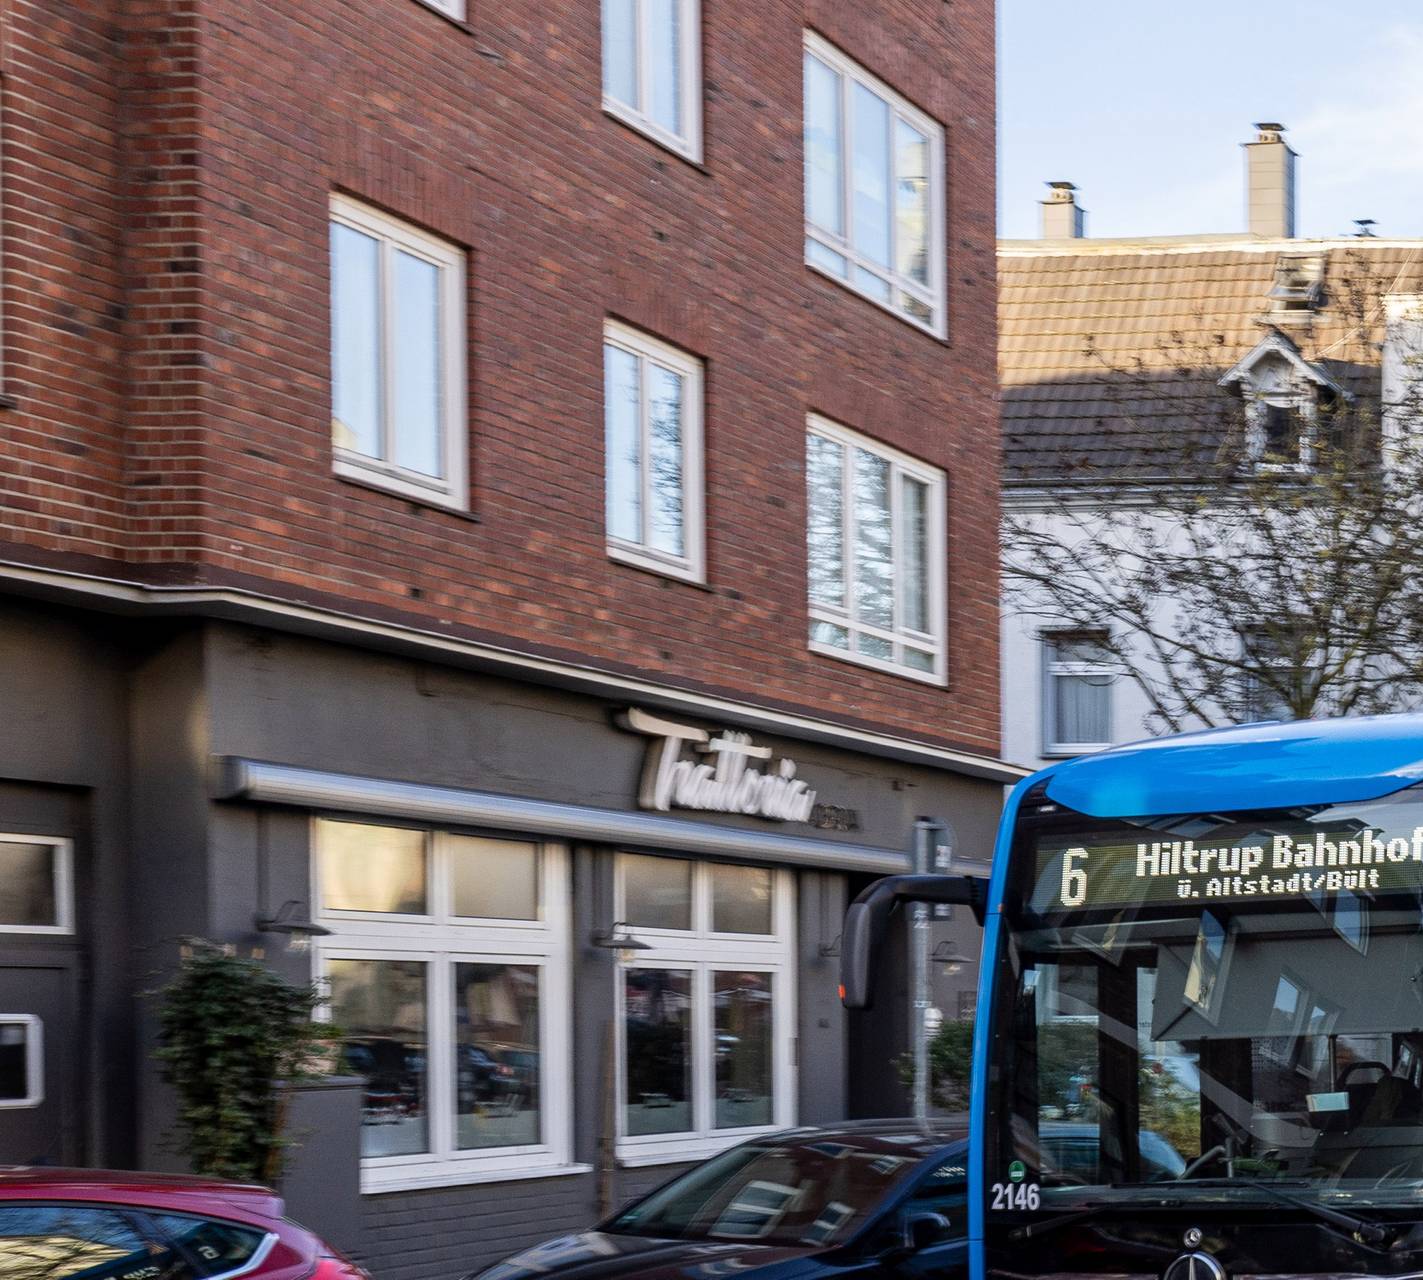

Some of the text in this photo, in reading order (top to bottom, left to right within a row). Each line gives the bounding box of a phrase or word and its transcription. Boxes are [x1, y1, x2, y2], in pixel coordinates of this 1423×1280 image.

[628, 706, 817, 824] Trattoria
[1060, 848, 1089, 907] 6
[1135, 841, 1263, 876] Hiltrup
[1177, 868, 1380, 898] ü. Altstadt/Bült
[991, 1183, 1040, 1211] 2146
